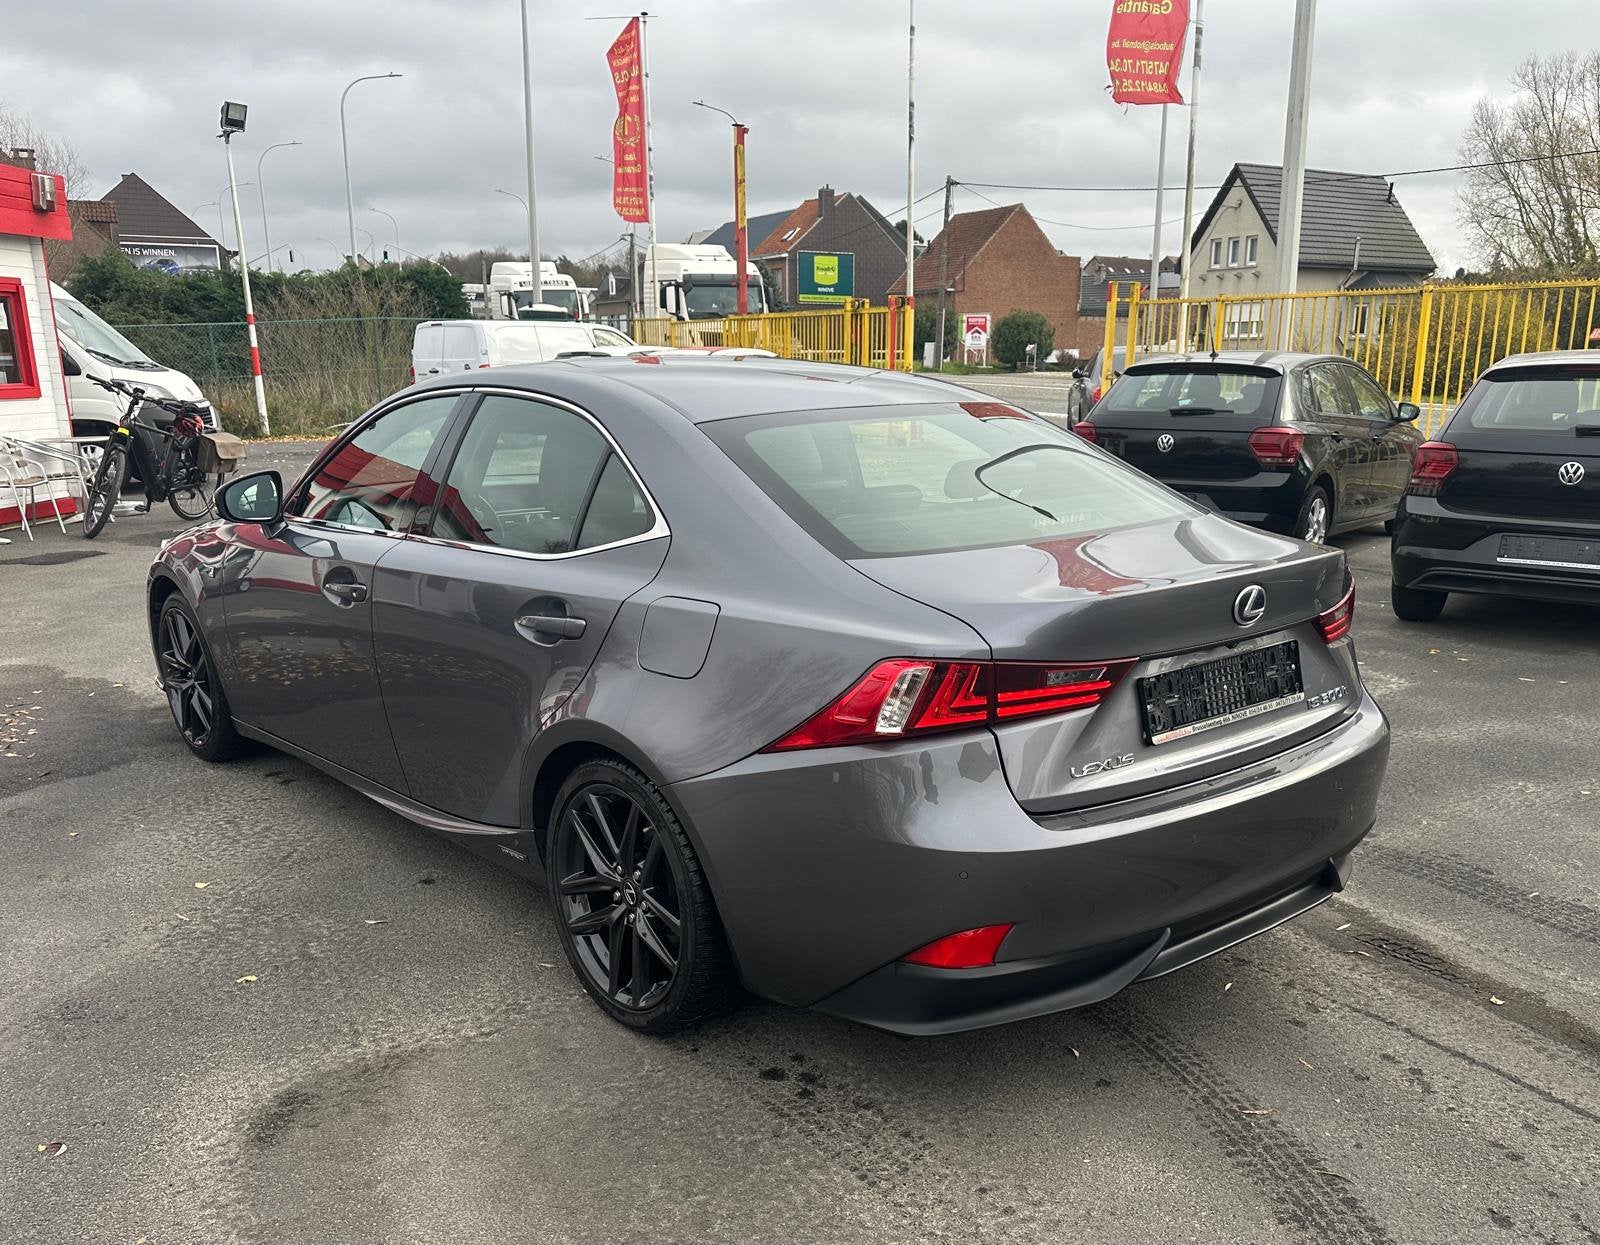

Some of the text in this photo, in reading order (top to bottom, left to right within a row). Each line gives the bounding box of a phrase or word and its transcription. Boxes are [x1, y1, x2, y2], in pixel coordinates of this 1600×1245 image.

[132, 248, 141, 256] IS
[141, 248, 177, 256] WINNEN.
[1070, 753, 1135, 779] LEXUS
